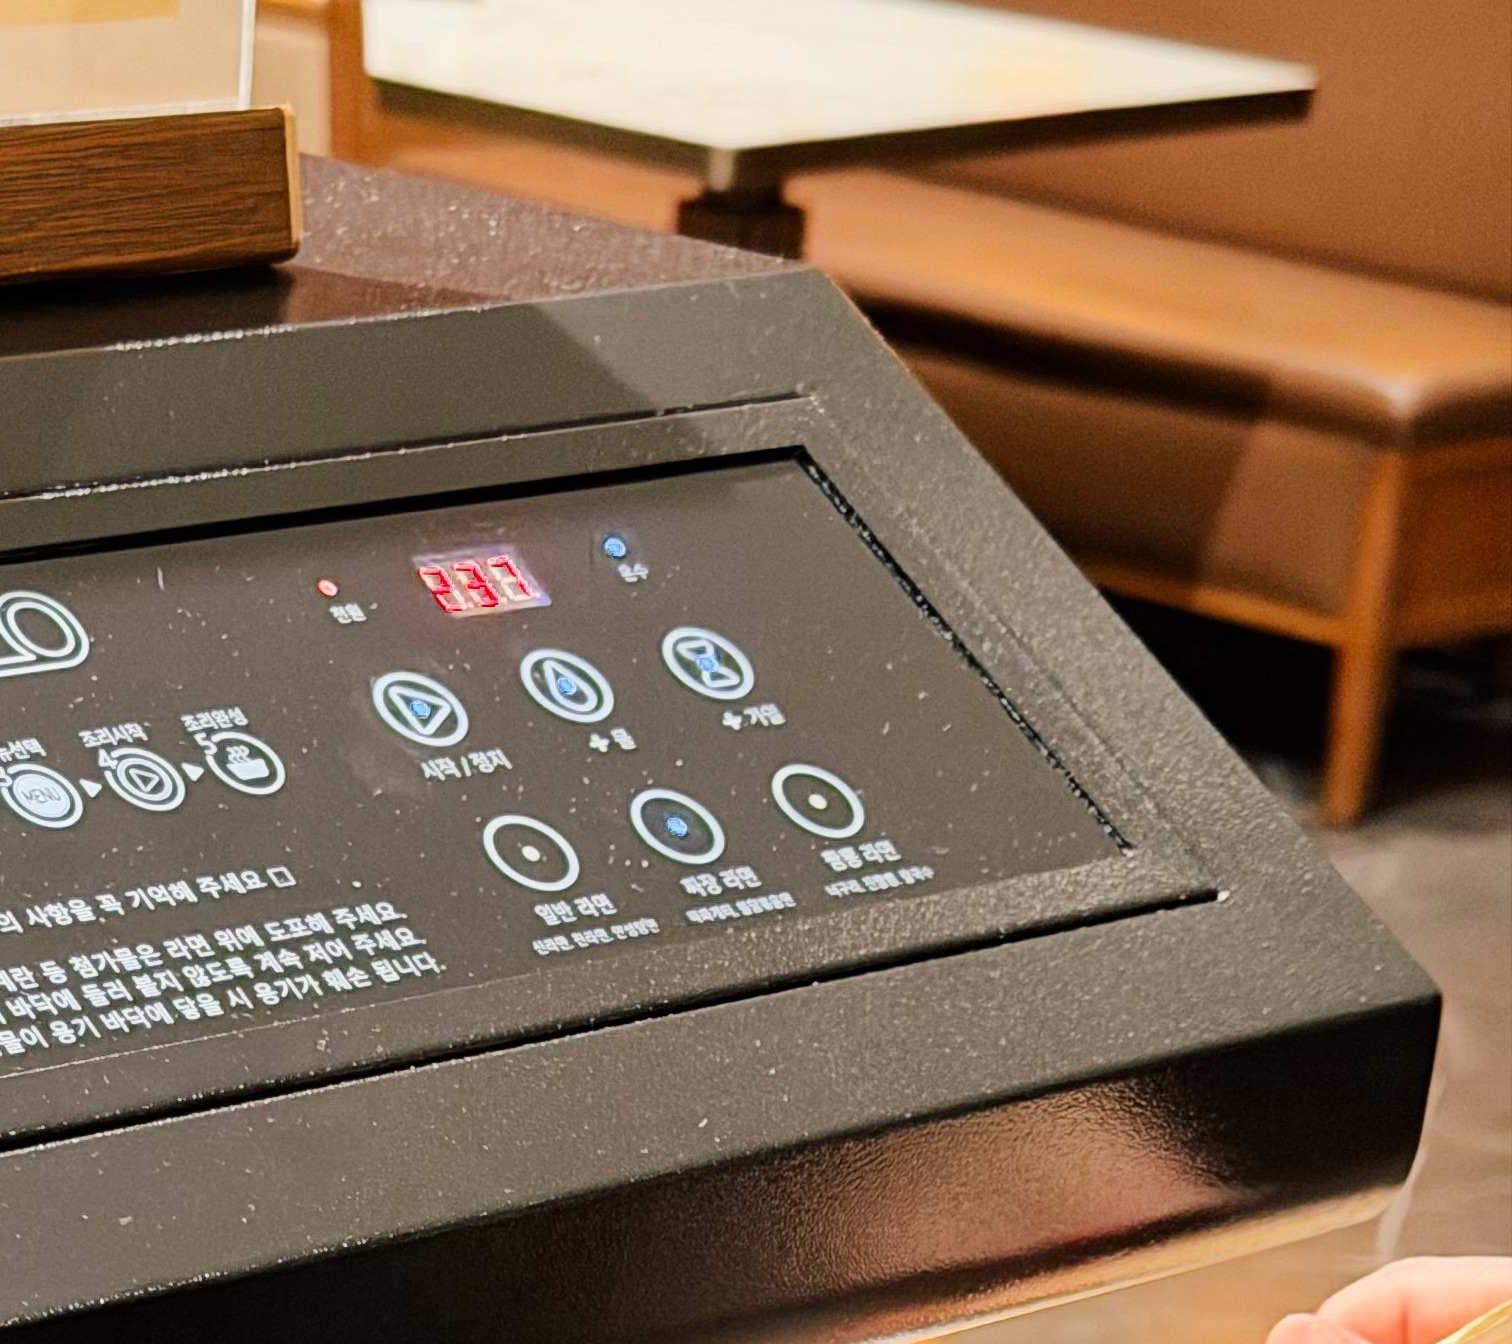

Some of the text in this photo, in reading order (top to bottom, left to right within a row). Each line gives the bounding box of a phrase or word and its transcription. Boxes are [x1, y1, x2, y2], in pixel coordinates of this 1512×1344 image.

[417, 554, 535, 614] 237
[79, 722, 148, 748] 조리시작
[21, 786, 62, 804] MENU
[26, 898, 96, 928] 사항을
[95, 894, 125, 915] 꼭
[125, 880, 198, 911] 기억해
[196, 870, 267, 899] 주세요
[40, 960, 68, 984] 등
[68, 944, 163, 979] 첨가물은
[163, 933, 215, 960] 라면
[213, 924, 265, 952] 위에
[264, 912, 335, 942] 도포해
[332, 901, 408, 930] 주세요.
[6, 988, 82, 1021] 바닥에
[181, 956, 255, 988] 않도록
[253, 949, 304, 973] 계속
[301, 938, 353, 964] 저어
[350, 927, 427, 956] 주세요.
[49, 1014, 101, 1044] 용기
[99, 1002, 175, 1034] 바닥에
[226, 986, 255, 1009] 시
[253, 973, 324, 1006] 용기가
[371, 951, 447, 983] 됩니다.
